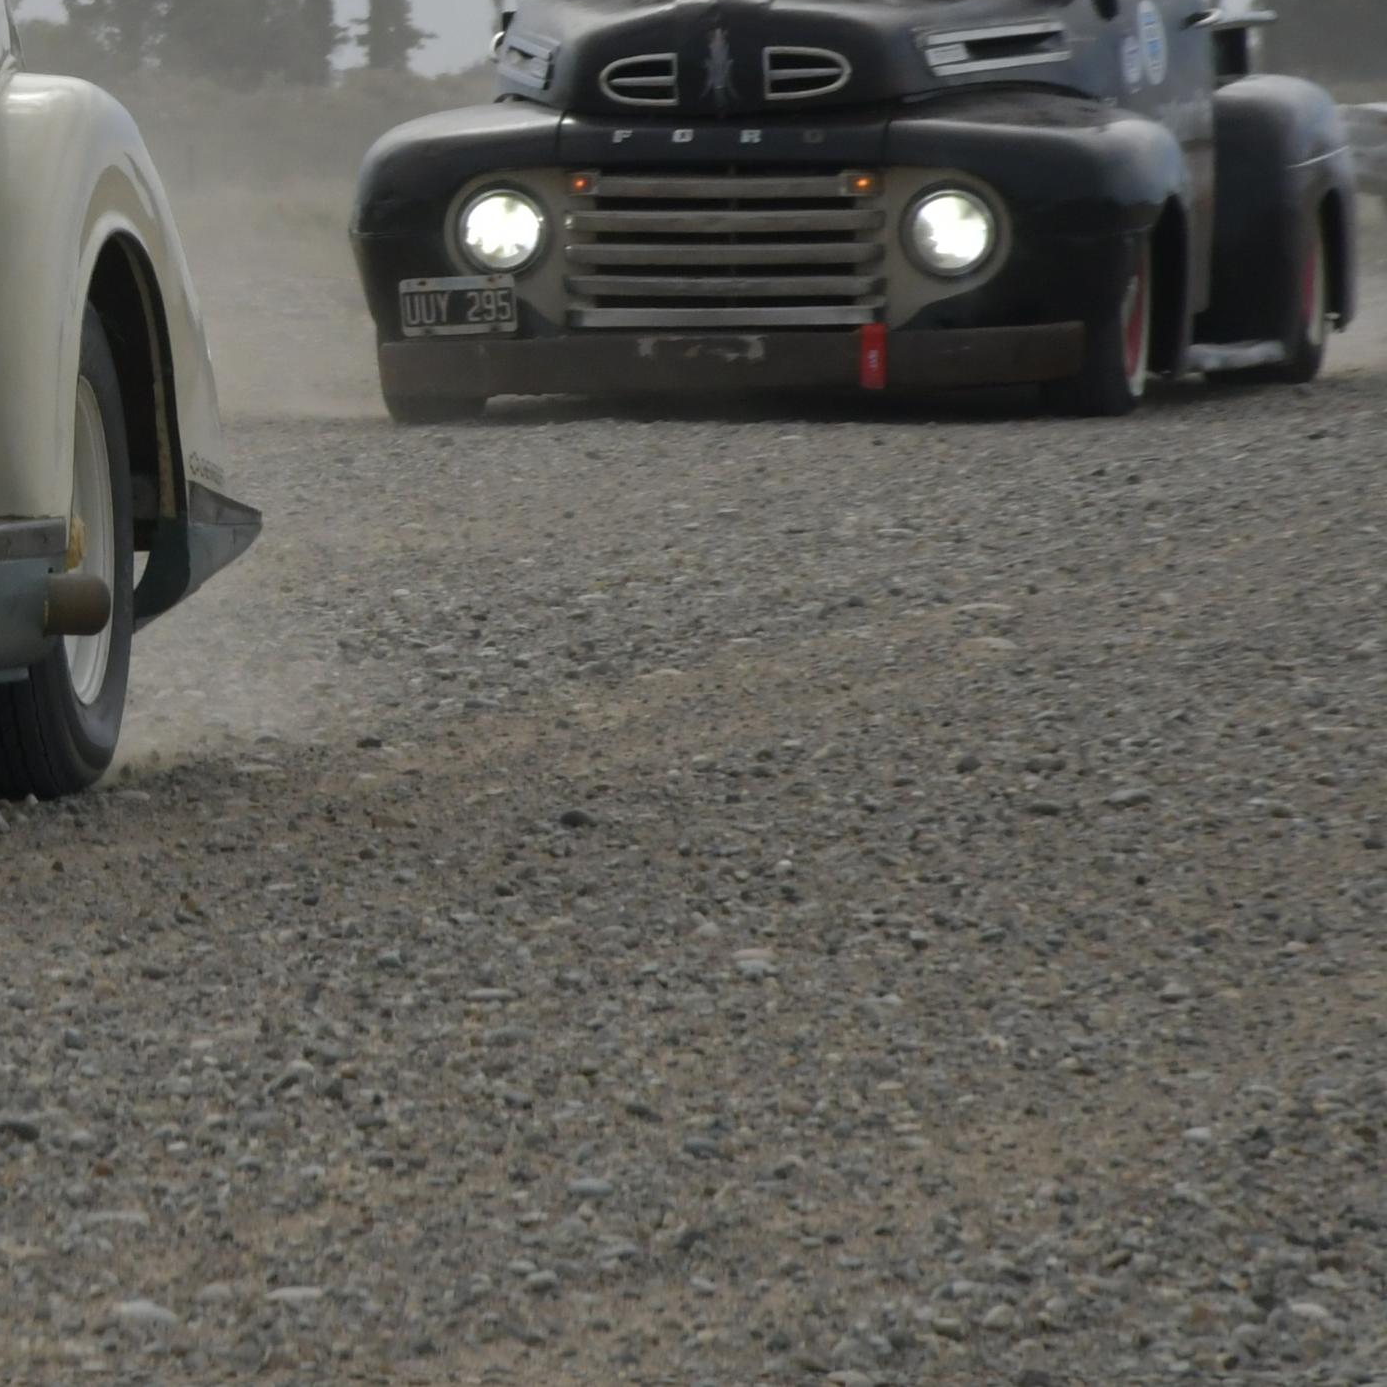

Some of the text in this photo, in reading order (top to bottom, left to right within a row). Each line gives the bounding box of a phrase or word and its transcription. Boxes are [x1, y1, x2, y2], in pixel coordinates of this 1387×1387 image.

[612, 128, 825, 144] FORD
[407, 289, 512, 325] UUY 295
